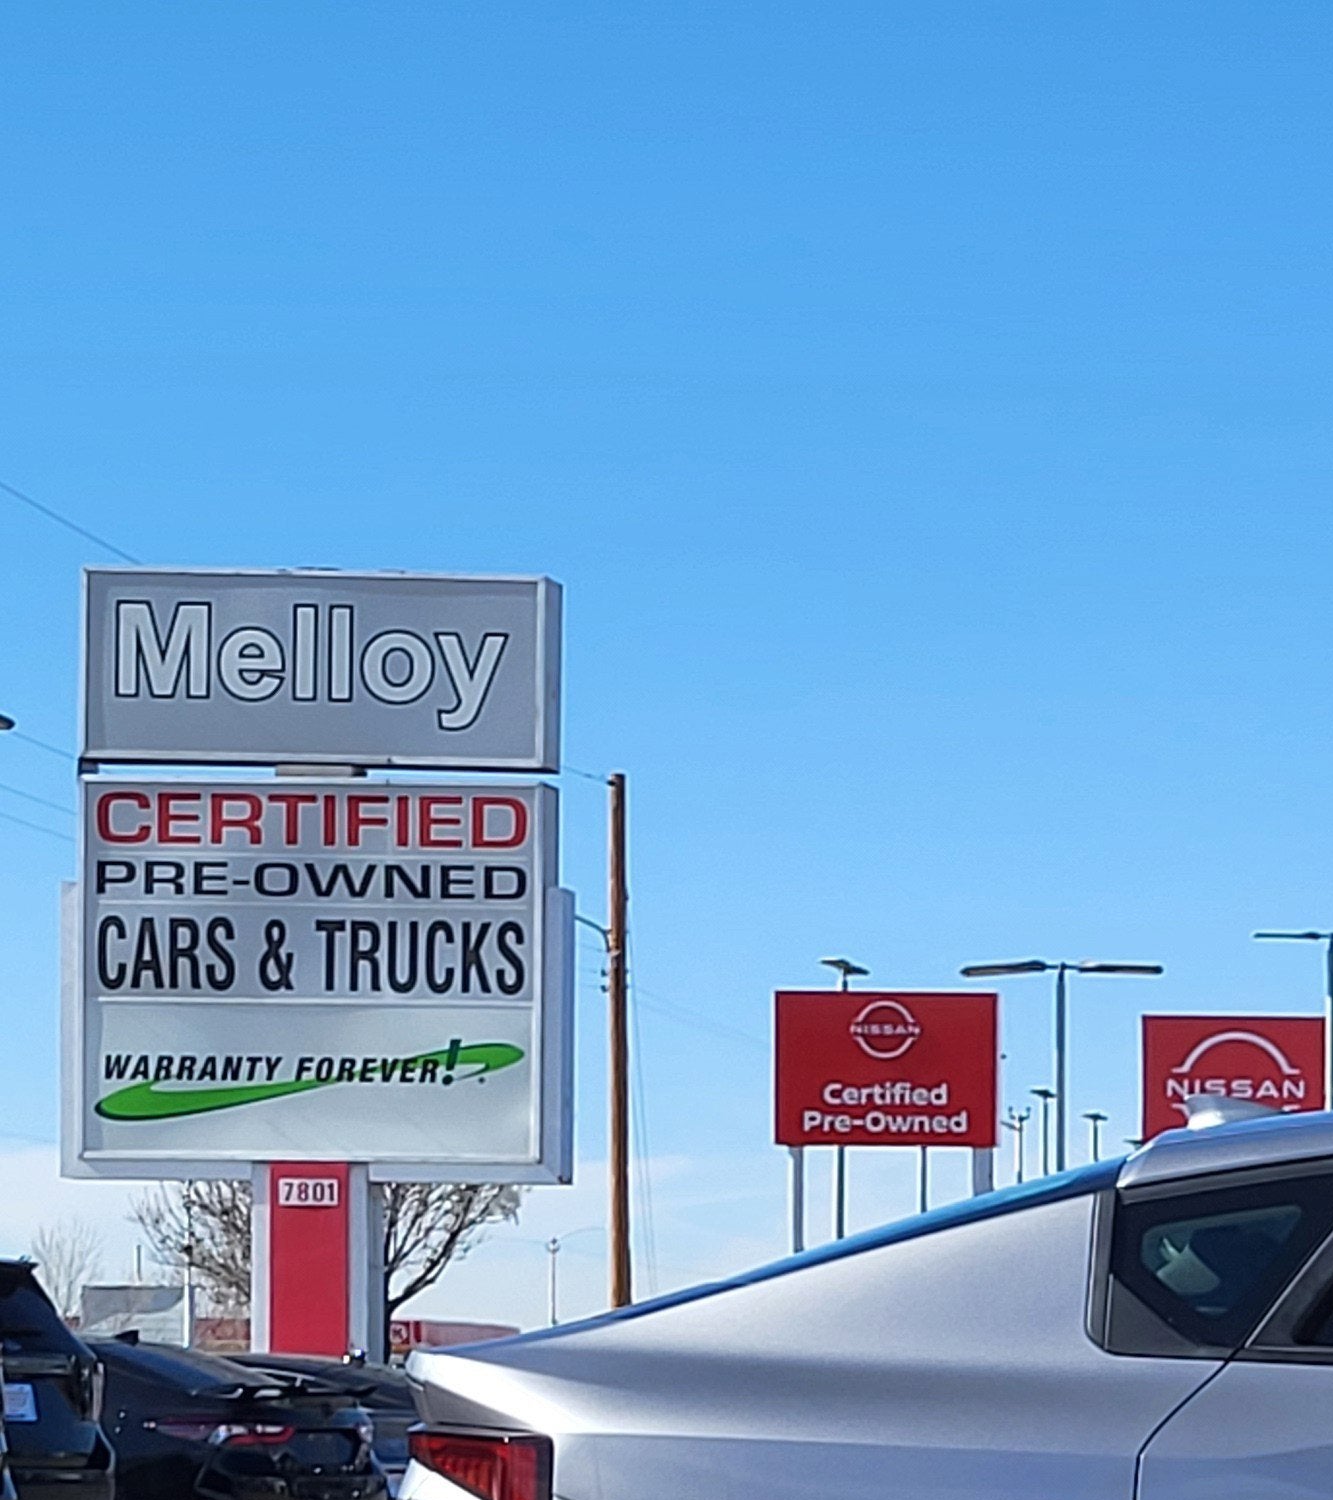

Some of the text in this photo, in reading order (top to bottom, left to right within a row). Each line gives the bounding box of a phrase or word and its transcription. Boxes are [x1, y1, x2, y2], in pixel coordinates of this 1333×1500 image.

[114, 599, 509, 731] Melloy
[95, 791, 528, 850] CERTIFIED
[96, 859, 528, 900] PRE-OWNED
[98, 914, 526, 995] CARS & TRUCKS
[849, 1022, 921, 1036] NISSAN
[104, 1038, 463, 1086] WARRANTY FOREVER!
[822, 1081, 949, 1107] Certified
[1166, 1078, 1306, 1099] NISSAN
[803, 1109, 969, 1134] Pre-Owned
[283, 1181, 335, 1202] 7801
